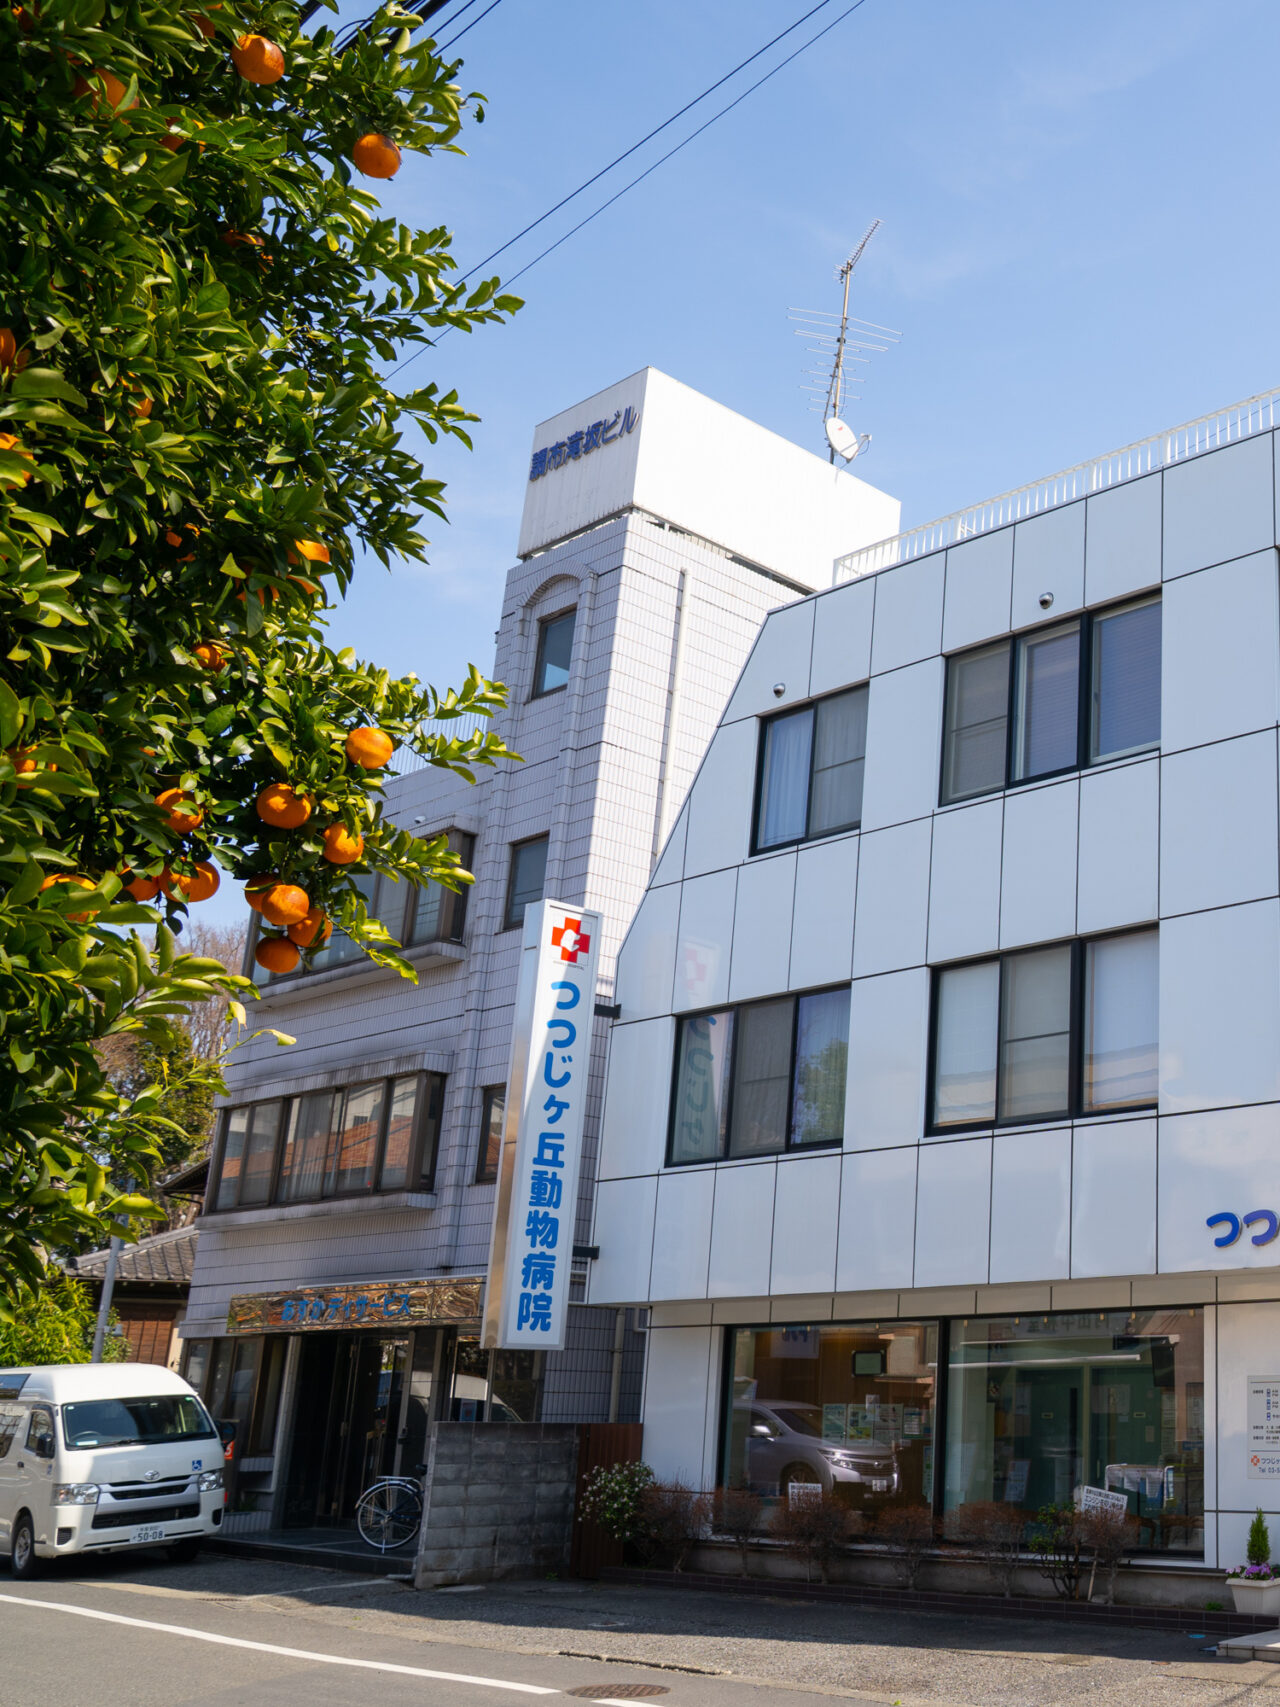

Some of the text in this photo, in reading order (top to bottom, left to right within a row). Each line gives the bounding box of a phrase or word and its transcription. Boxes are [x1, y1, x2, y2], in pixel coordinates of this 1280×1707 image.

[517, 980, 582, 1333] つつじヶ丘動物病院
[137, 1530, 164, 1542] 50-08
